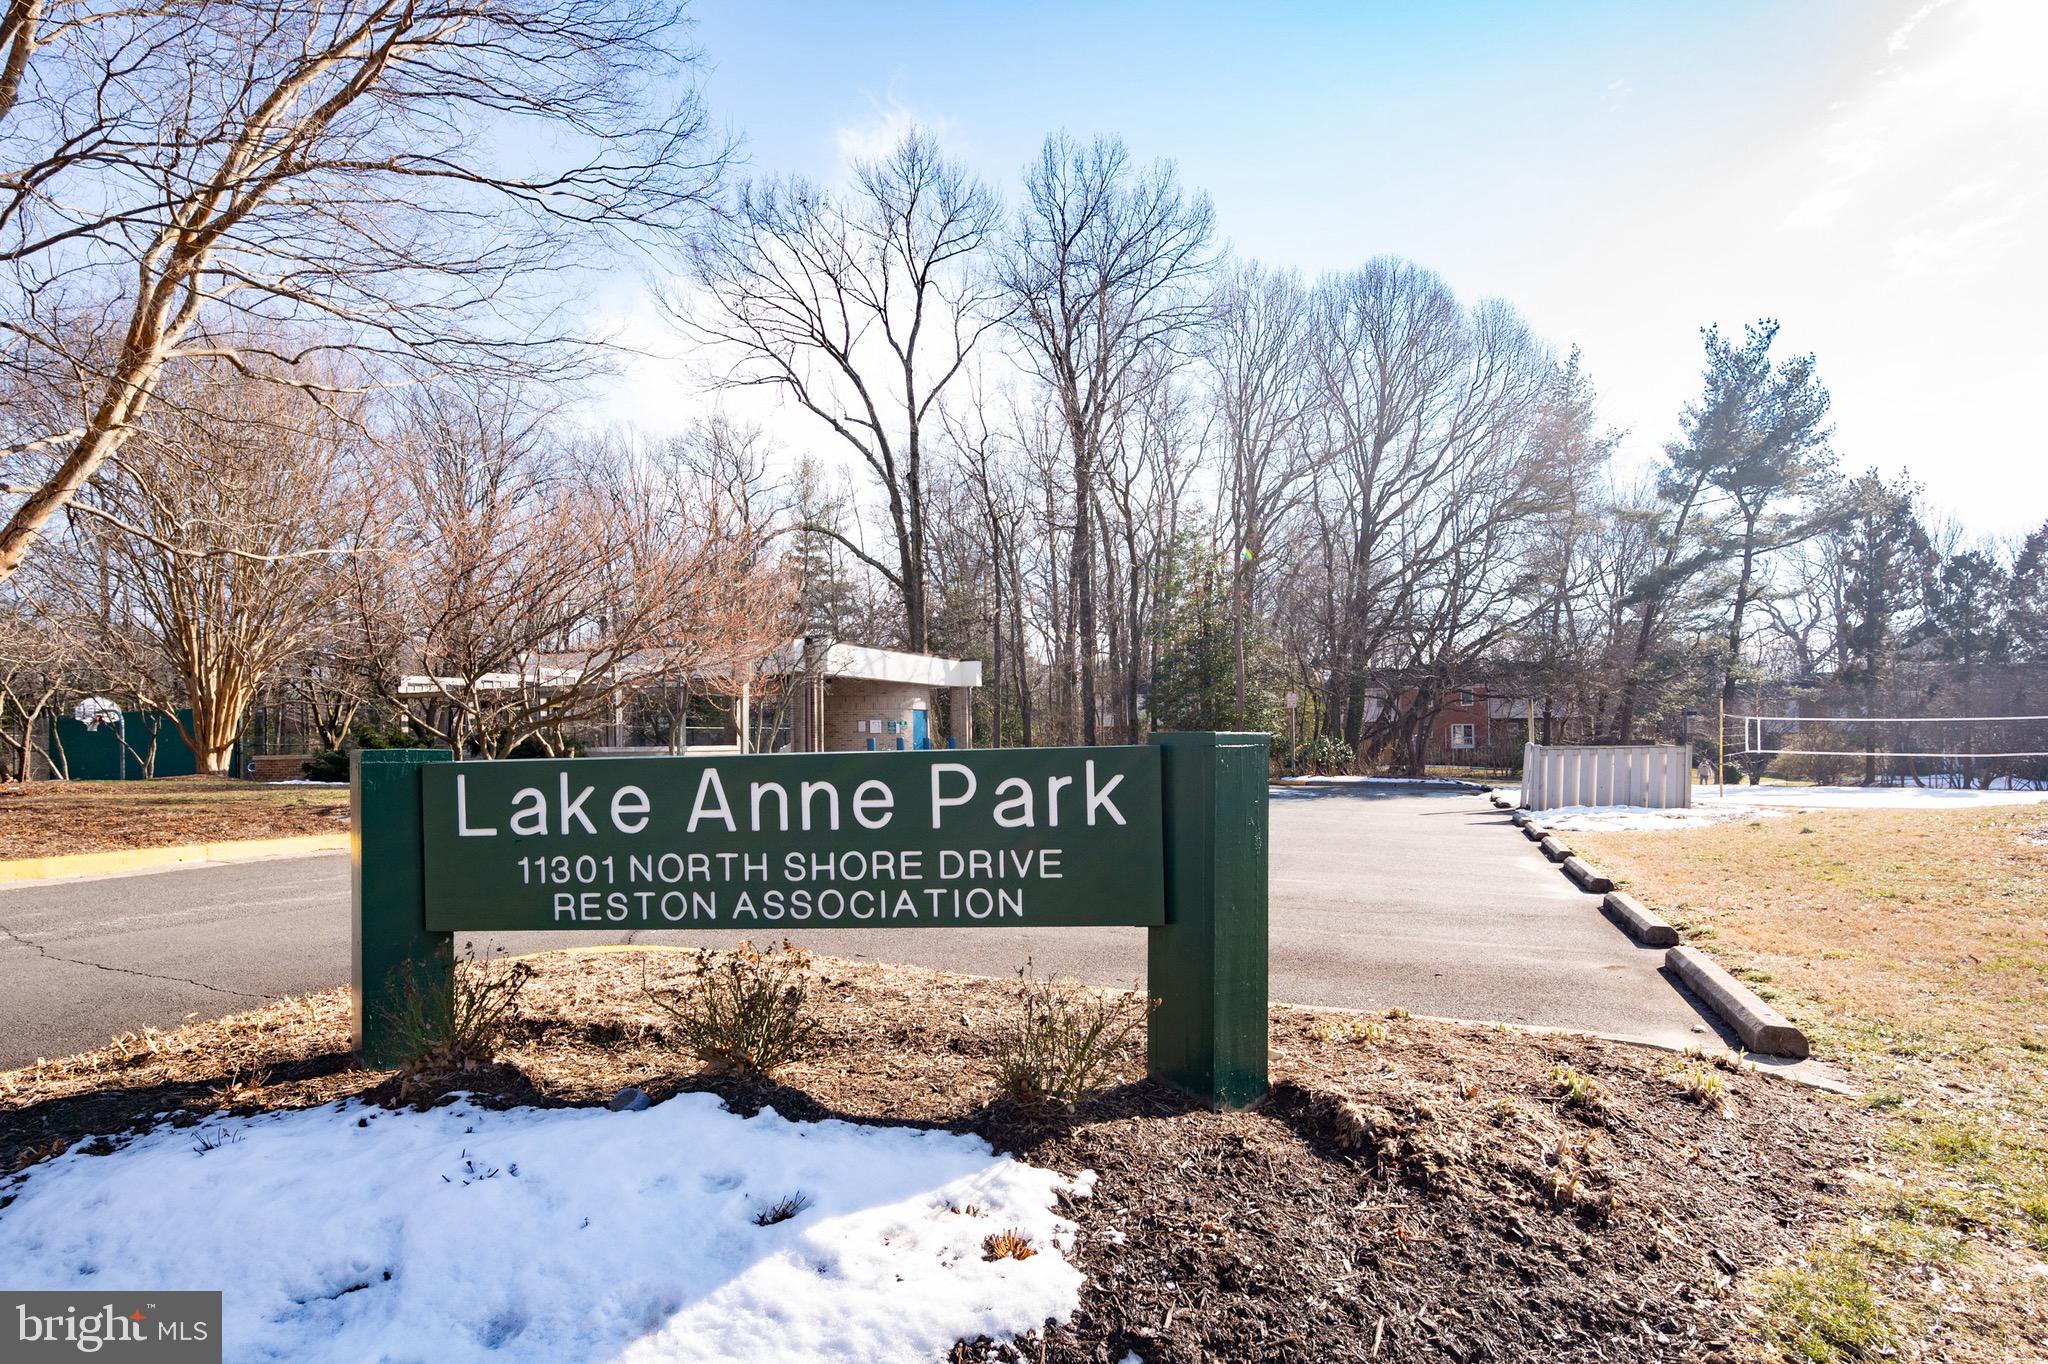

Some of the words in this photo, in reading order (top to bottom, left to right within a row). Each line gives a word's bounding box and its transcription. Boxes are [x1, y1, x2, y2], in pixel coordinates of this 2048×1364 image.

[457, 772, 651, 837] Lake
[686, 767, 894, 833] Anne
[931, 759, 1127, 829] Park
[518, 855, 614, 884] 11301
[630, 852, 768, 882] NORTH
[784, 850, 923, 881] SHORE
[939, 849, 1063, 879] DRIVE
[554, 891, 716, 921] RESTON
[732, 888, 1023, 920] ASSOCIATION
